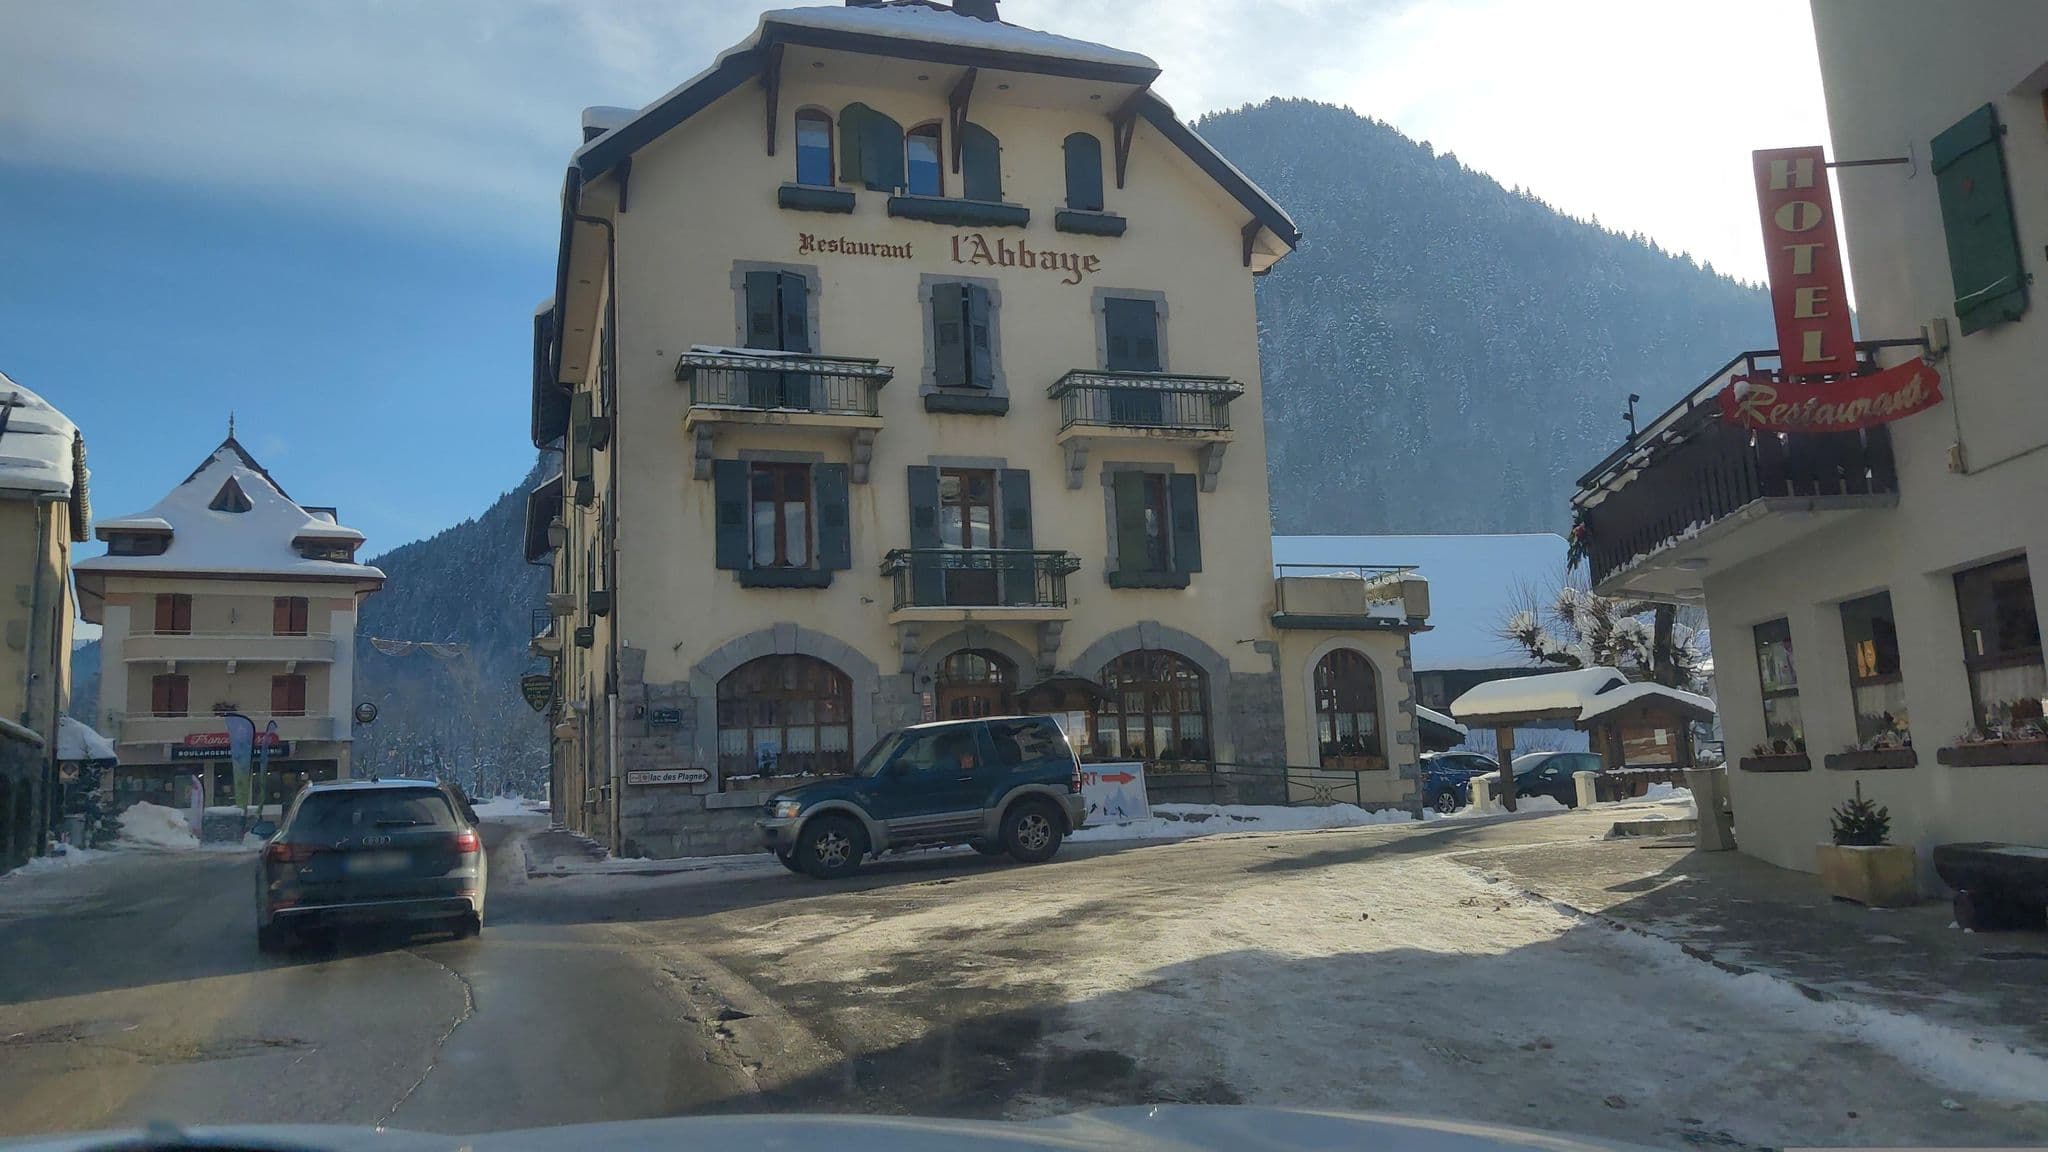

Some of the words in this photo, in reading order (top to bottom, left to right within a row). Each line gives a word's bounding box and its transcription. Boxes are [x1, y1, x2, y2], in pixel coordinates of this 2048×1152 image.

[798, 232, 914, 260] Restaurant
[951, 233, 1102, 286] l'Abbaye
[1769, 157, 1836, 363] HOTEL
[1734, 373, 1928, 427] Restaurant
[663, 773, 677, 781] des
[1082, 772, 1098, 785] RT
